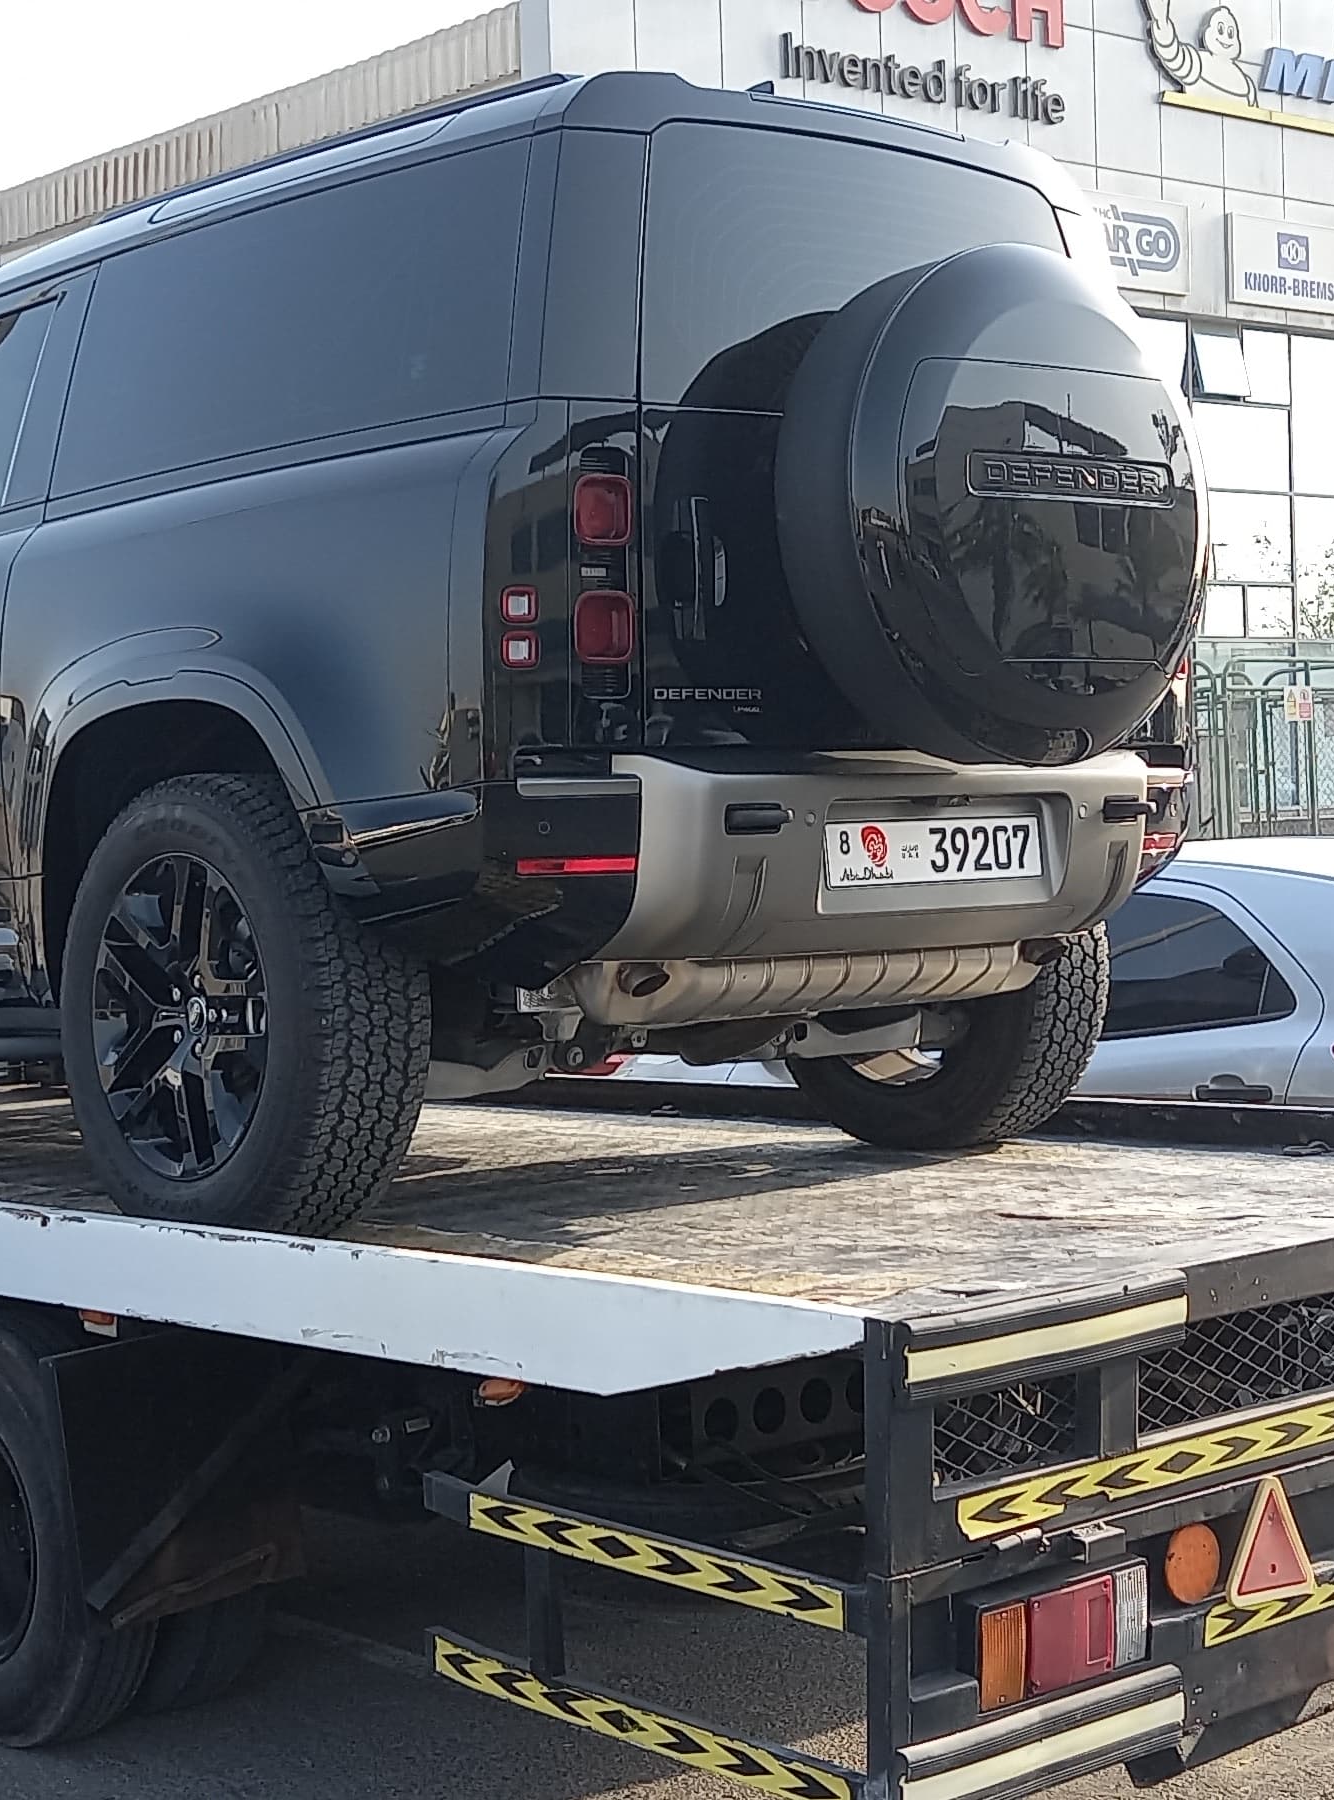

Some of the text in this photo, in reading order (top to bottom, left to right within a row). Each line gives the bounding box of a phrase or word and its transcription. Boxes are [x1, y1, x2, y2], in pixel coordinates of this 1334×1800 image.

[779, 31, 1066, 125] Invented for life
[982, 460, 1165, 498] DEFENDER
[653, 687, 763, 700] DEFENDER
[838, 830, 851, 855] 8
[928, 824, 1031, 873] 39207
